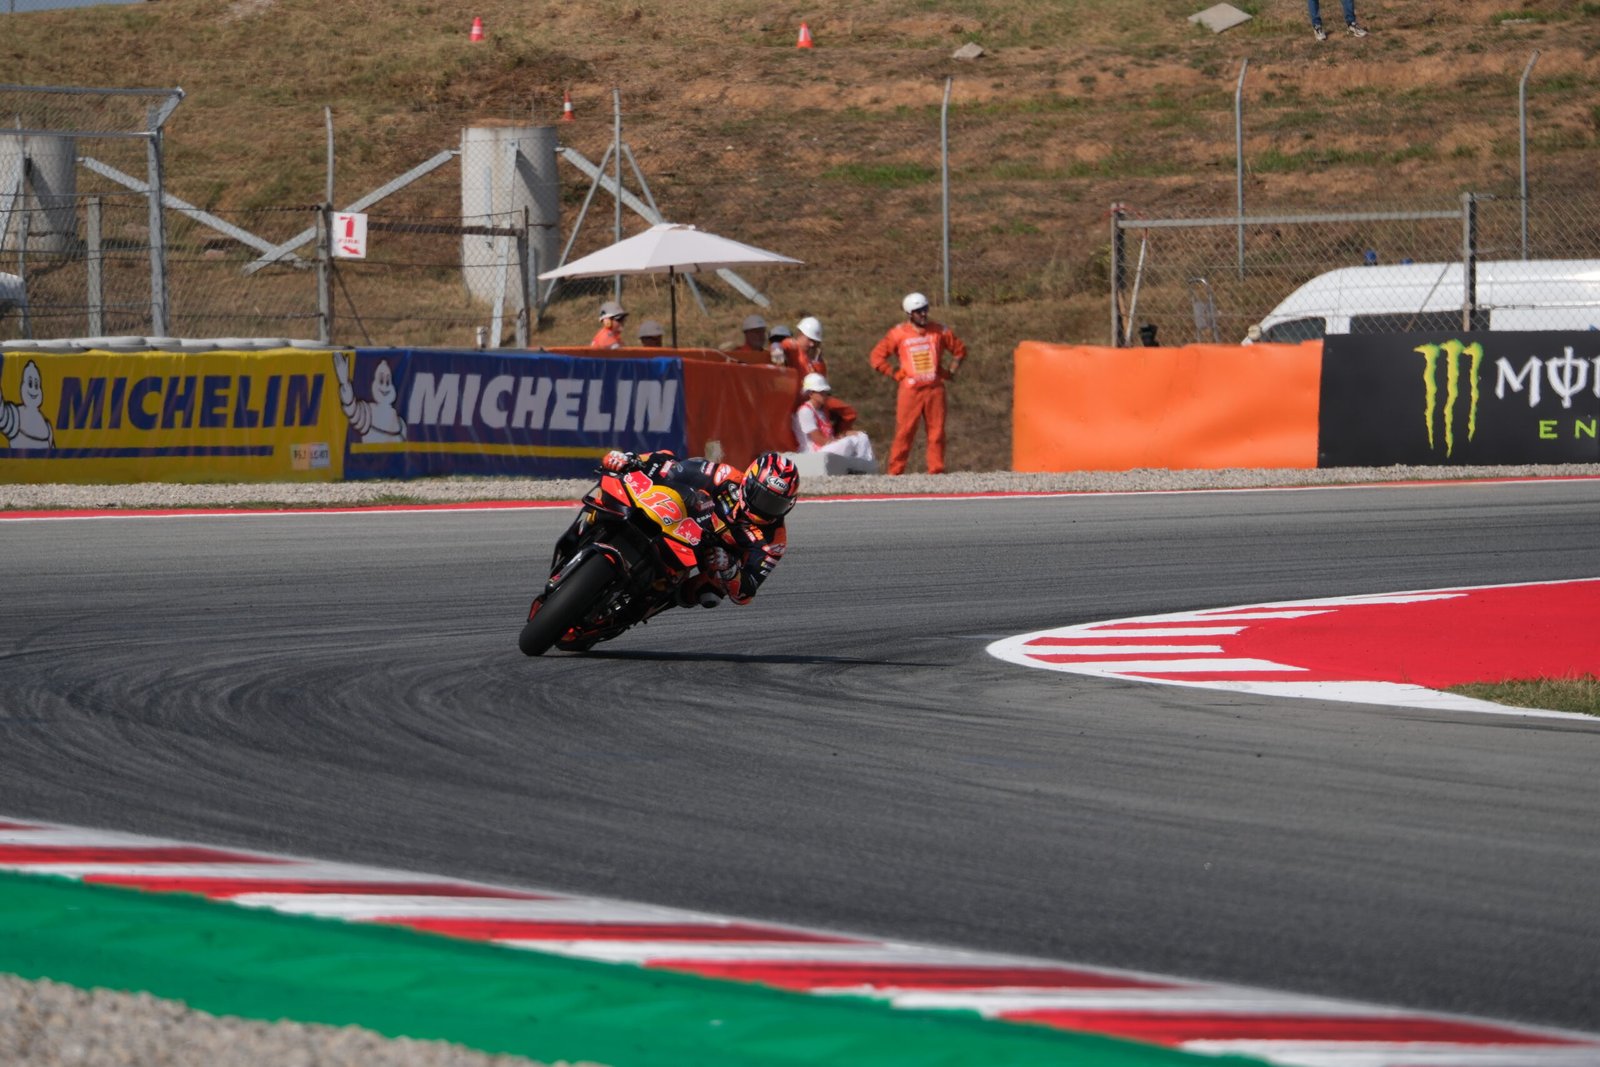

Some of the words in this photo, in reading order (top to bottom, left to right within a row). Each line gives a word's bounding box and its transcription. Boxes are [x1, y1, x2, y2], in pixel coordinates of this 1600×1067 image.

[56, 373, 325, 431] MICHELIN
[407, 372, 678, 433] MICHELIN
[638, 491, 683, 523] 12
